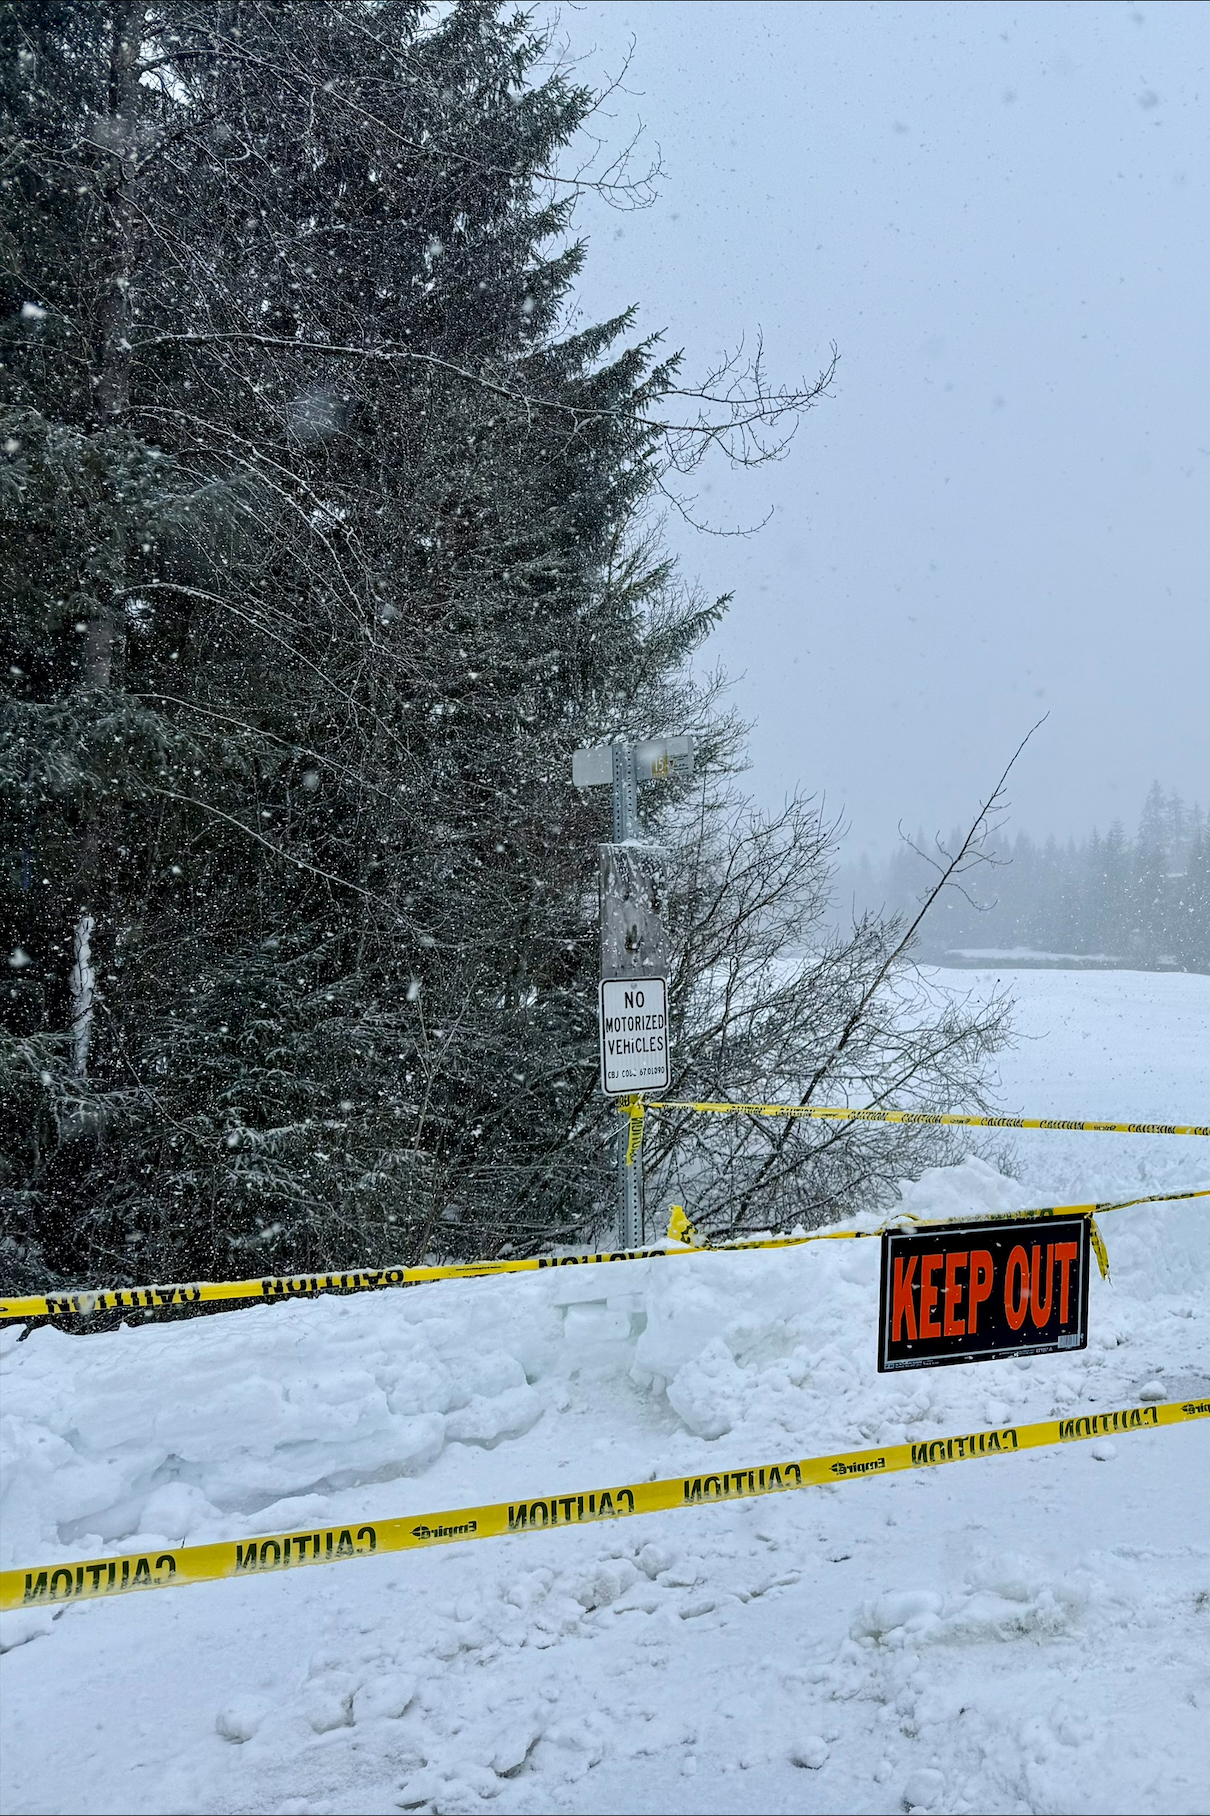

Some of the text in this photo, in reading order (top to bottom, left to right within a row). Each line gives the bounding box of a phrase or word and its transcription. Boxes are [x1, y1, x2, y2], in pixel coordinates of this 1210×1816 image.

[625, 991, 645, 1009] NO
[606, 1015, 664, 1033] MOTORIZED
[608, 1036, 664, 1055] VEHICLES
[892, 1242, 1078, 1342] KEEP OUT
